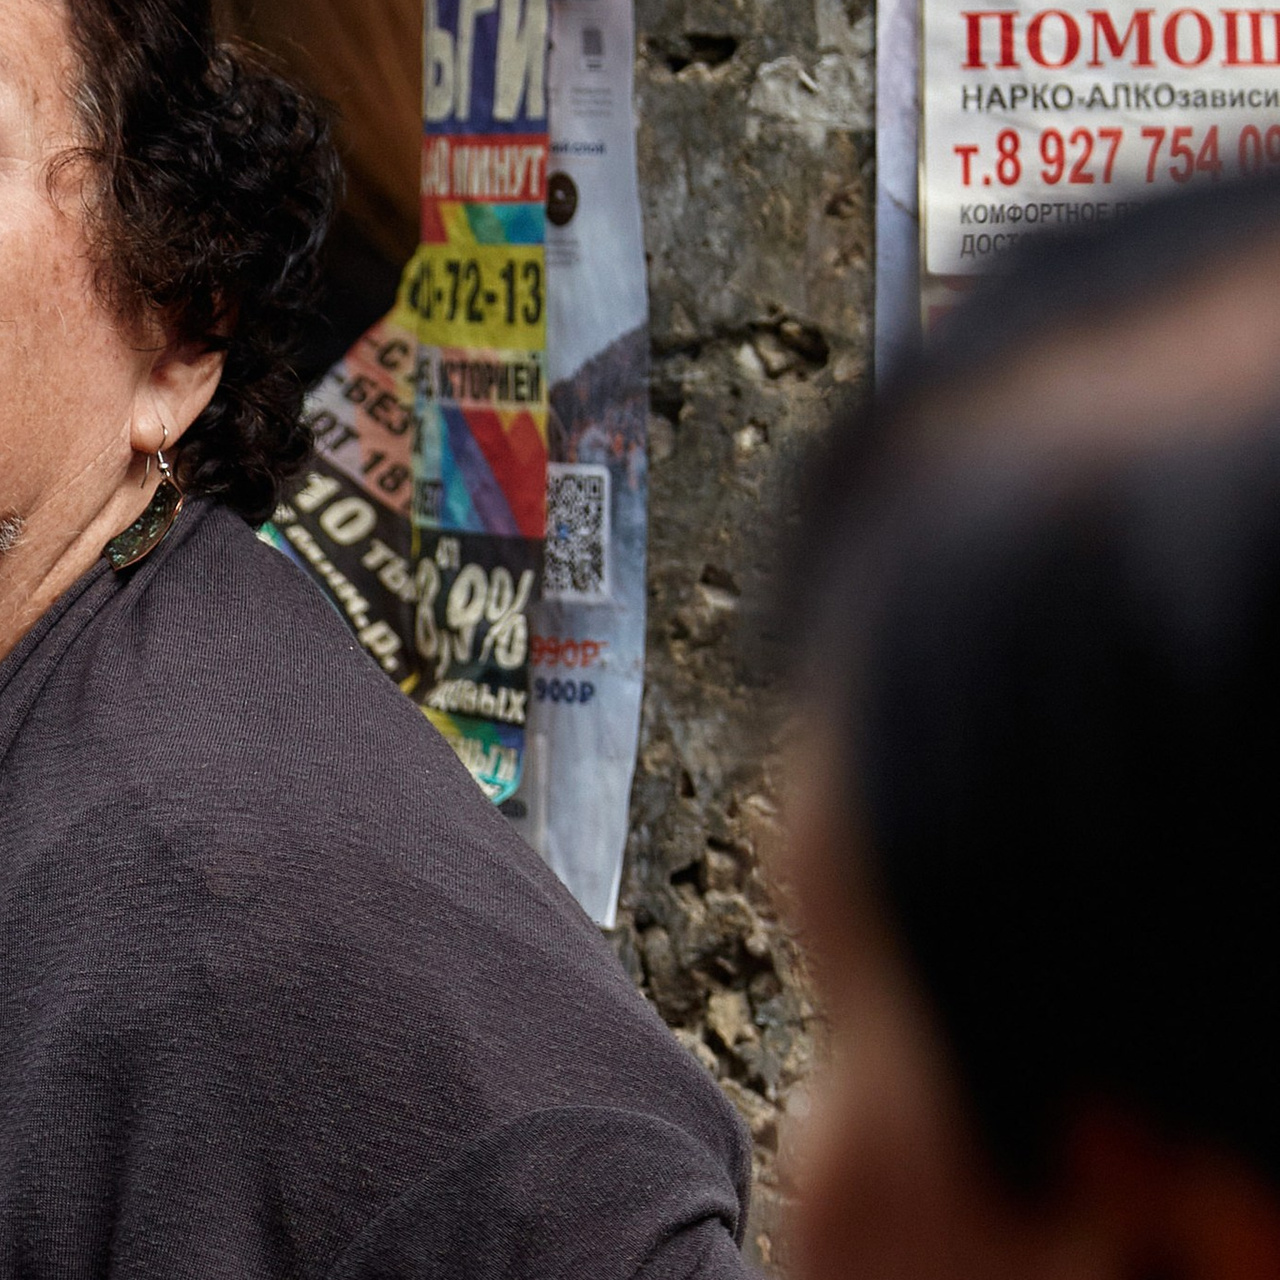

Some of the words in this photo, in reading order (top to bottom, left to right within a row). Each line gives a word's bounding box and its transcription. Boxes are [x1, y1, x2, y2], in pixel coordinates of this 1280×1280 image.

[1039, 127, 1123, 184] 927
[1141, 125, 1223, 183] 754
[294, 471, 379, 546] 10
